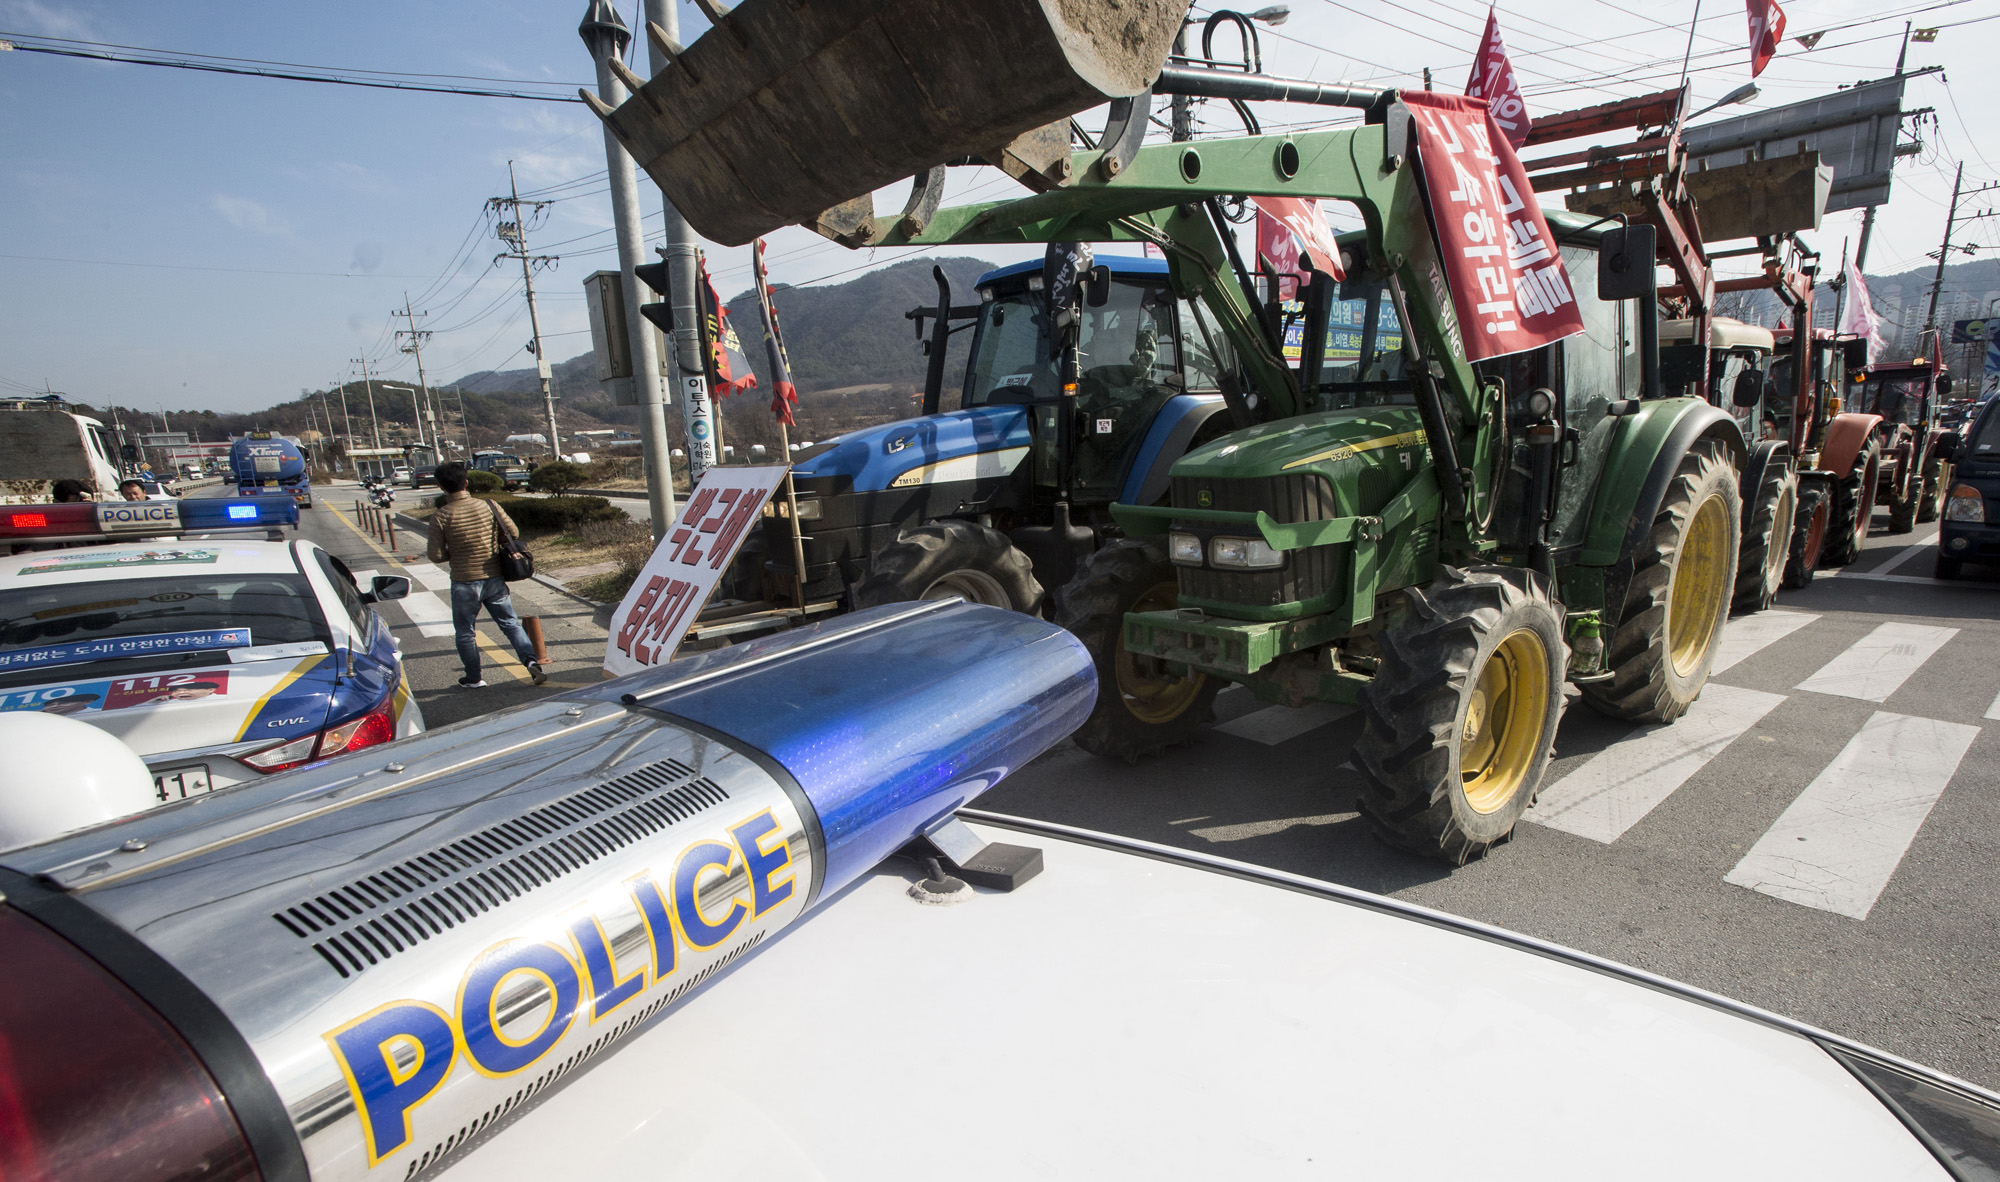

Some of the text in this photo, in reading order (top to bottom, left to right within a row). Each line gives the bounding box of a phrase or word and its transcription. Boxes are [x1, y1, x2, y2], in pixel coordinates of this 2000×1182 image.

[1424, 110, 1517, 334] 구속하라!
[1465, 122, 1573, 318] 박근혜를
[1329, 301, 1351, 324] 의원
[1428, 261, 1462, 359] TAESUNG
[688, 378, 707, 417] 이투스
[248, 447, 283, 456] XTeer
[693, 441, 711, 450] 기숙
[695, 450, 712, 459] 학원
[887, 437, 905, 454] LS
[1330, 450, 1353, 462] 6320
[103, 508, 174, 523] POLICE
[670, 488, 768, 570] 박근혜
[617, 574, 699, 666] 퇴진!
[0, 635, 212, 665] 범죄없는 도시! 안전한 안성!
[117, 674, 197, 691] 112
[267, 716, 310, 728] CVVL
[154, 773, 187, 801] 41
[321, 806, 797, 1170] POLICE
